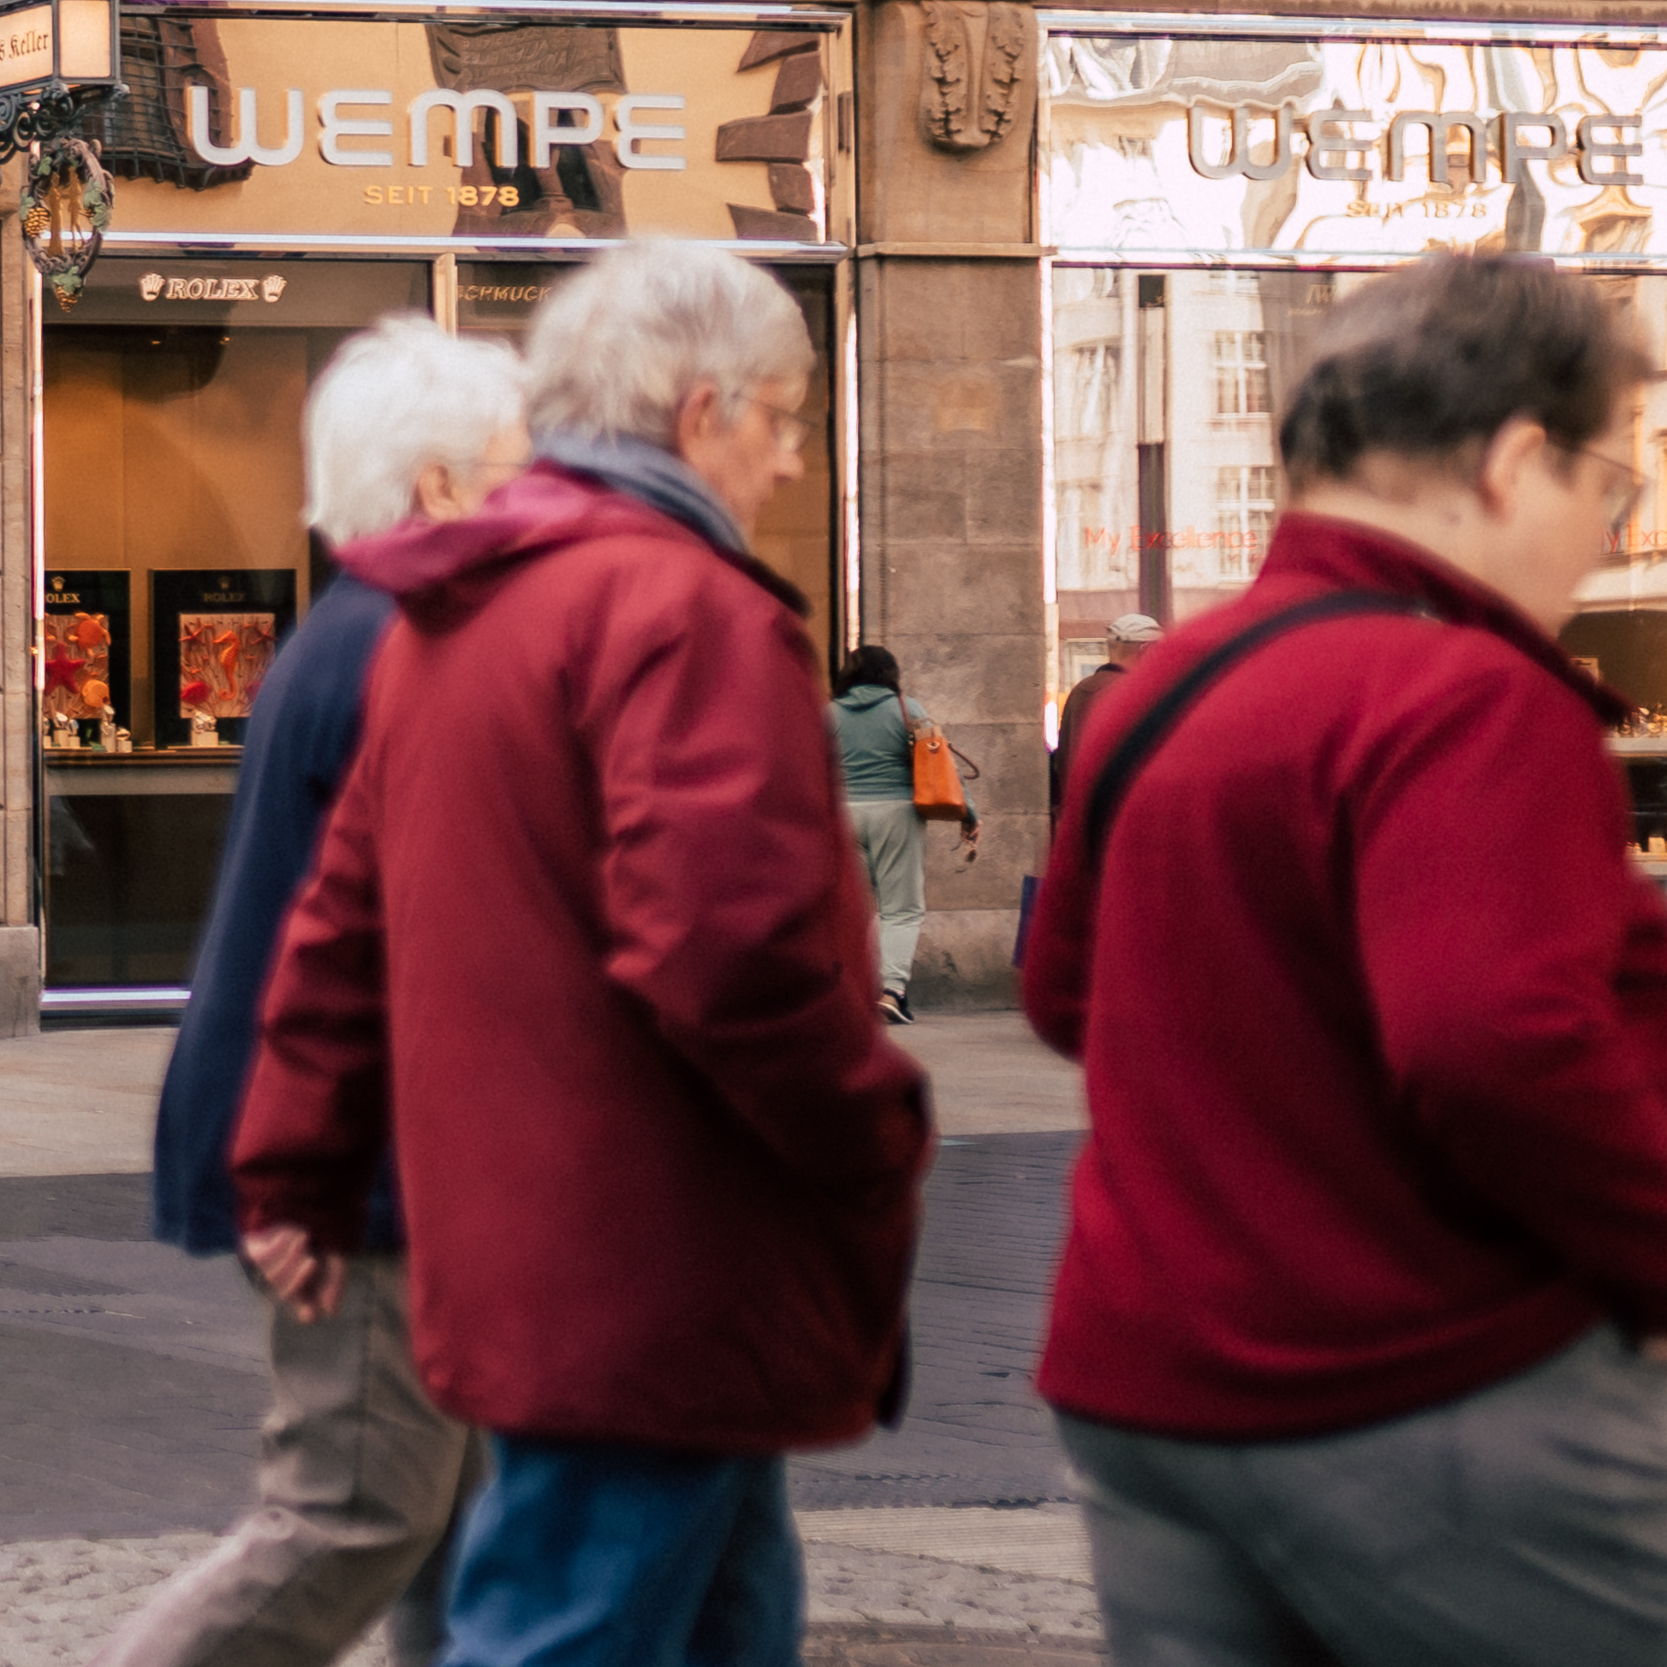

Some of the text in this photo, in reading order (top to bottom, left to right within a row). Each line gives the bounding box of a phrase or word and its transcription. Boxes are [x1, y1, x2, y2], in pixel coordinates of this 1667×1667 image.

[8, 29, 49, 60] Keller
[188, 87, 687, 171] WEMPE
[1187, 102, 1644, 185] WEMPE
[364, 185, 520, 207] SEIT 1878
[1422, 200, 1487, 218] 1878
[164, 277, 260, 301] ROLEX
[1084, 524, 1258, 556] My Excellence
[45, 593, 80, 603] OLEX
